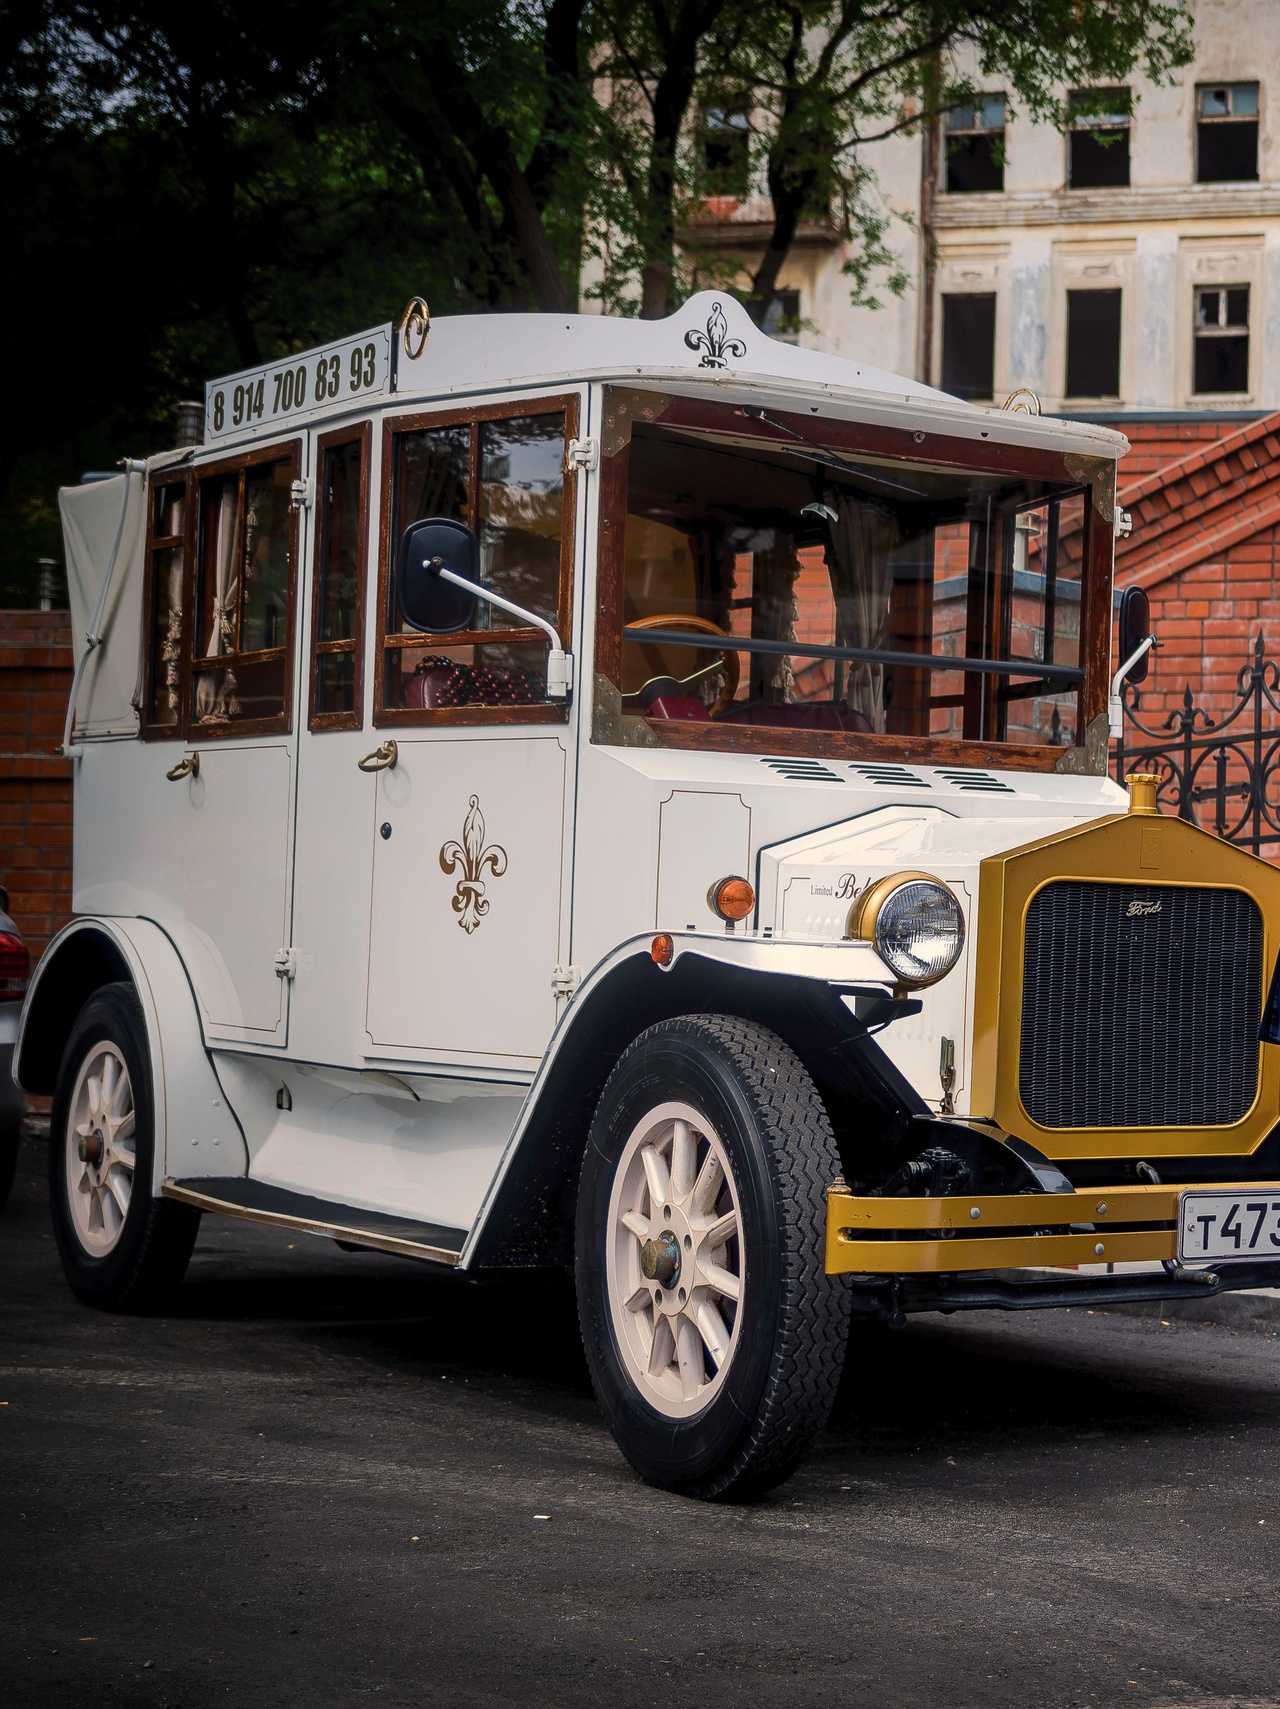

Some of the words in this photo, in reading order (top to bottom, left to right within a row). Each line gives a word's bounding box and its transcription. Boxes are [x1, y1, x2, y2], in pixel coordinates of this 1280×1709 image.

[213, 390, 225, 432] 8
[232, 379, 265, 426] 914
[272, 365, 307, 414] 700
[314, 354, 341, 402] 83
[349, 343, 376, 392] 93
[810, 884, 833, 896] Limited
[1125, 901, 1162, 917] Ford
